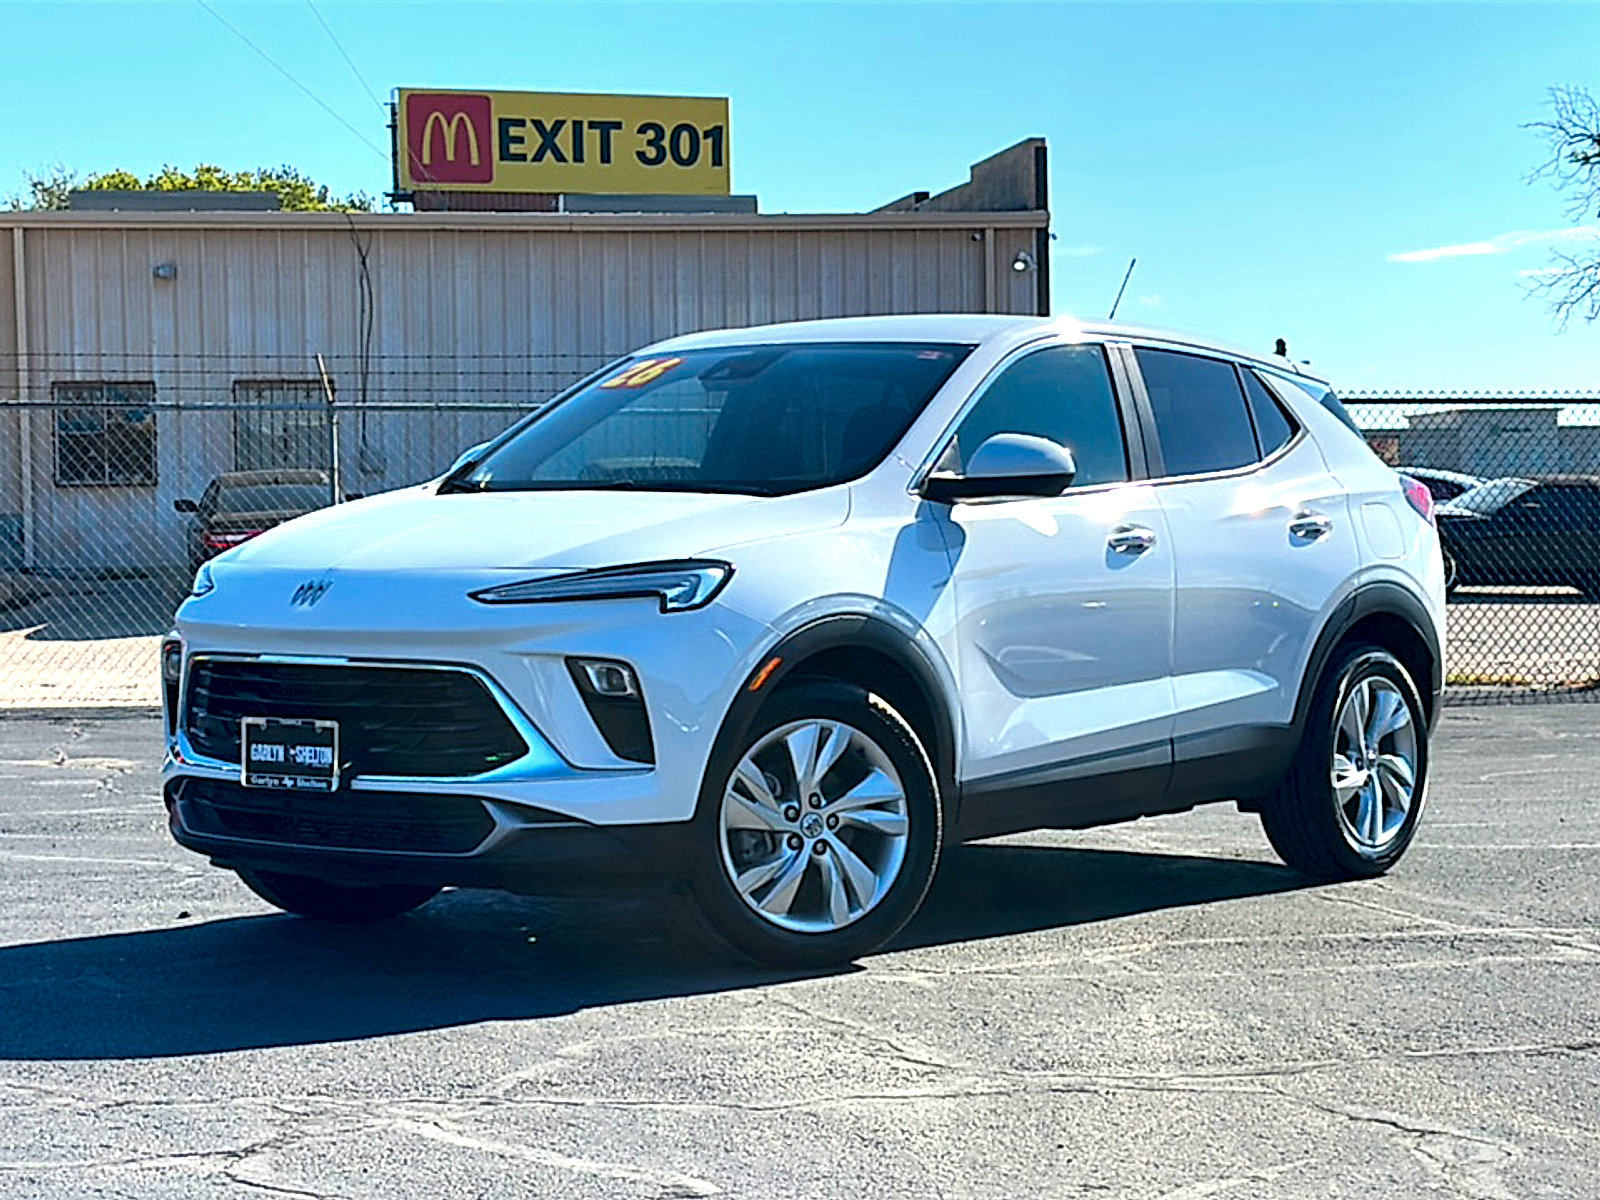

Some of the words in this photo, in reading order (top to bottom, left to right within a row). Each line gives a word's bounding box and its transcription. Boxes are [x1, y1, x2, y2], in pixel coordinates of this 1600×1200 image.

[498, 118, 623, 165] EXIT
[635, 122, 725, 168] 301
[600, 357, 682, 388] 26
